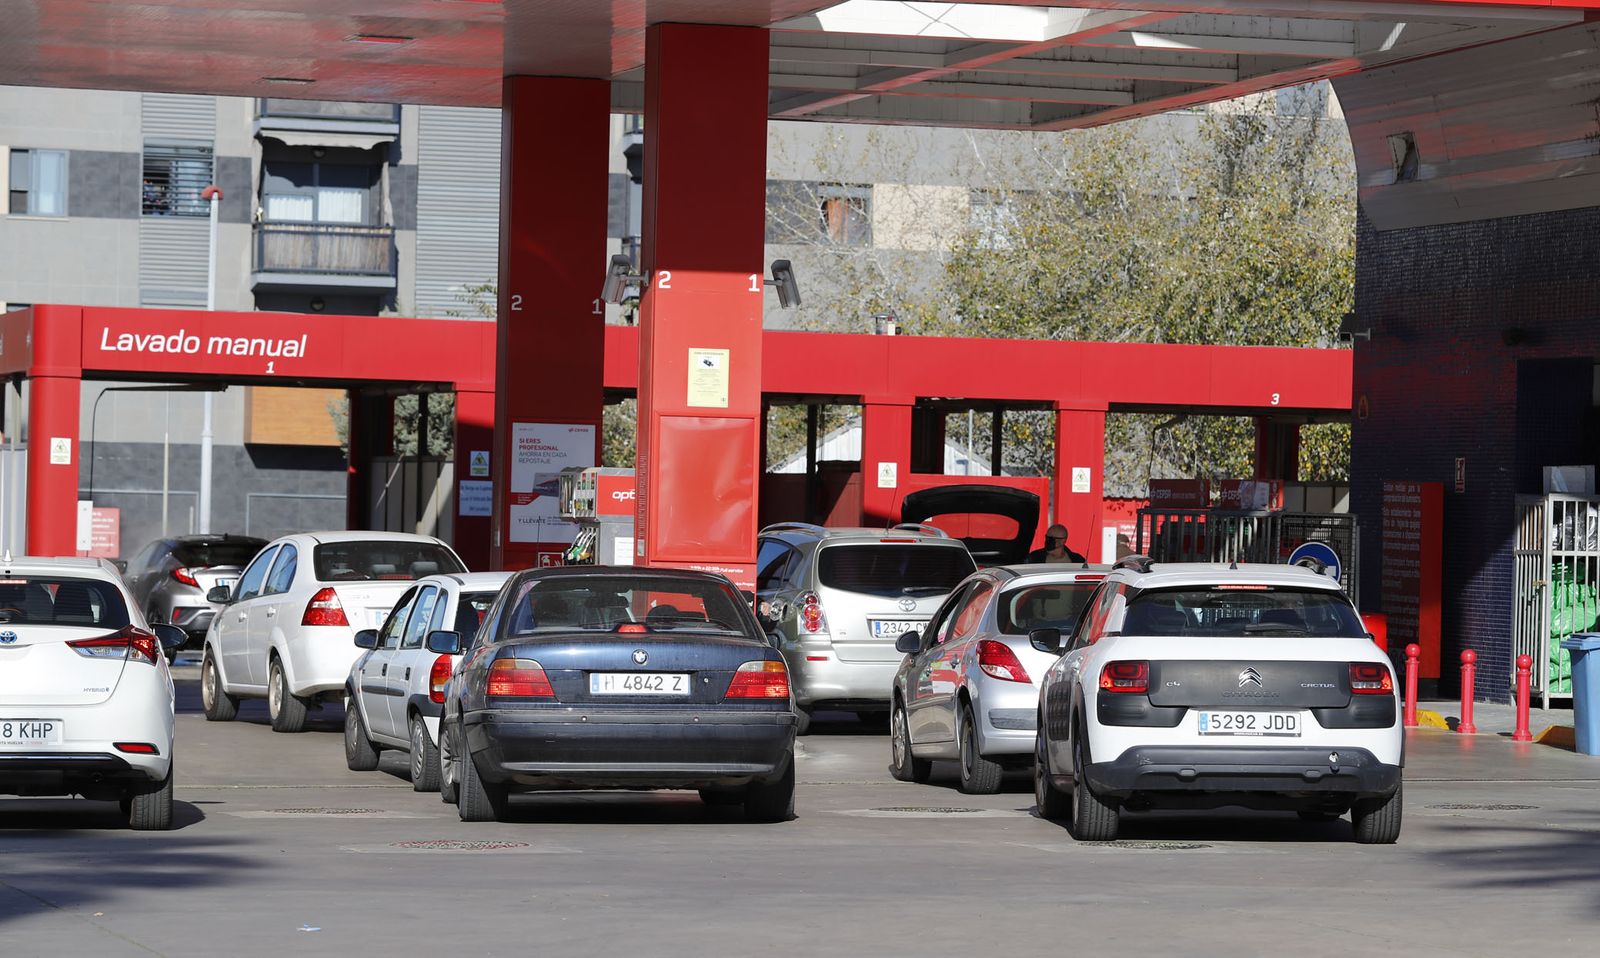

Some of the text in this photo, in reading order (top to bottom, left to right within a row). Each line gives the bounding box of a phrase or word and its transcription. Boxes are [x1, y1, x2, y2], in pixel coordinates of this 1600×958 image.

[658, 271, 671, 289] 2
[748, 274, 760, 292] 1
[511, 295, 522, 311] 2
[592, 299, 602, 315] 1
[100, 327, 307, 358] Lavado manual
[265, 361, 275, 374] 1
[1270, 392, 1280, 405] 3
[883, 622, 911, 634] 2342
[623, 675, 664, 691] 4842
[672, 676, 682, 691] Z
[19, 722, 54, 739] KHP
[1211, 714, 1296, 731] 5292 JDD
